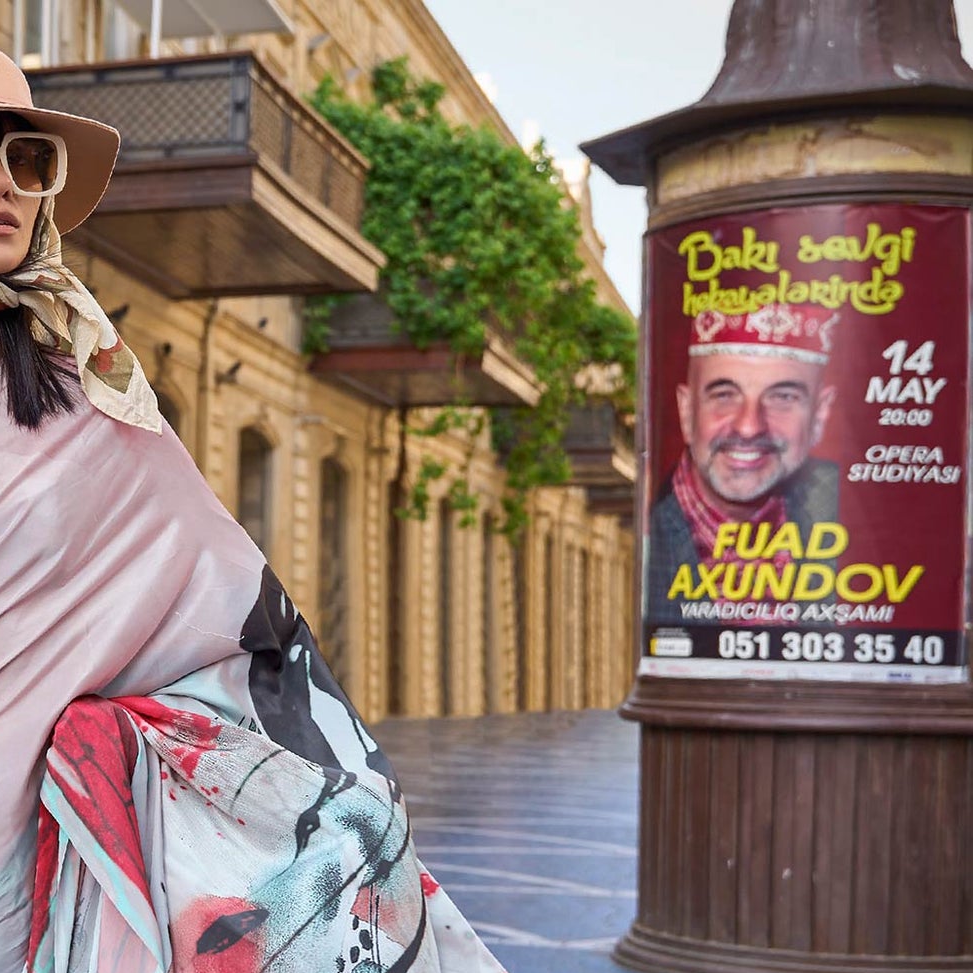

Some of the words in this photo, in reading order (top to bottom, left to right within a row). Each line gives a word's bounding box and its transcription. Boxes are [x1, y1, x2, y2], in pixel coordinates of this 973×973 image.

[679, 226, 780, 281] Bakı
[797, 222, 917, 275] sevgi
[882, 340, 935, 375] 14
[865, 376, 947, 404] MAY
[878, 408, 933, 426] 20:00
[865, 445, 944, 465] OPERA
[712, 521, 850, 560] FUAD
[667, 562, 925, 603] AXUNDOV
[718, 630, 770, 660] 051
[781, 631, 845, 662] 303
[853, 633, 896, 663] 35
[904, 635, 945, 665] 40
